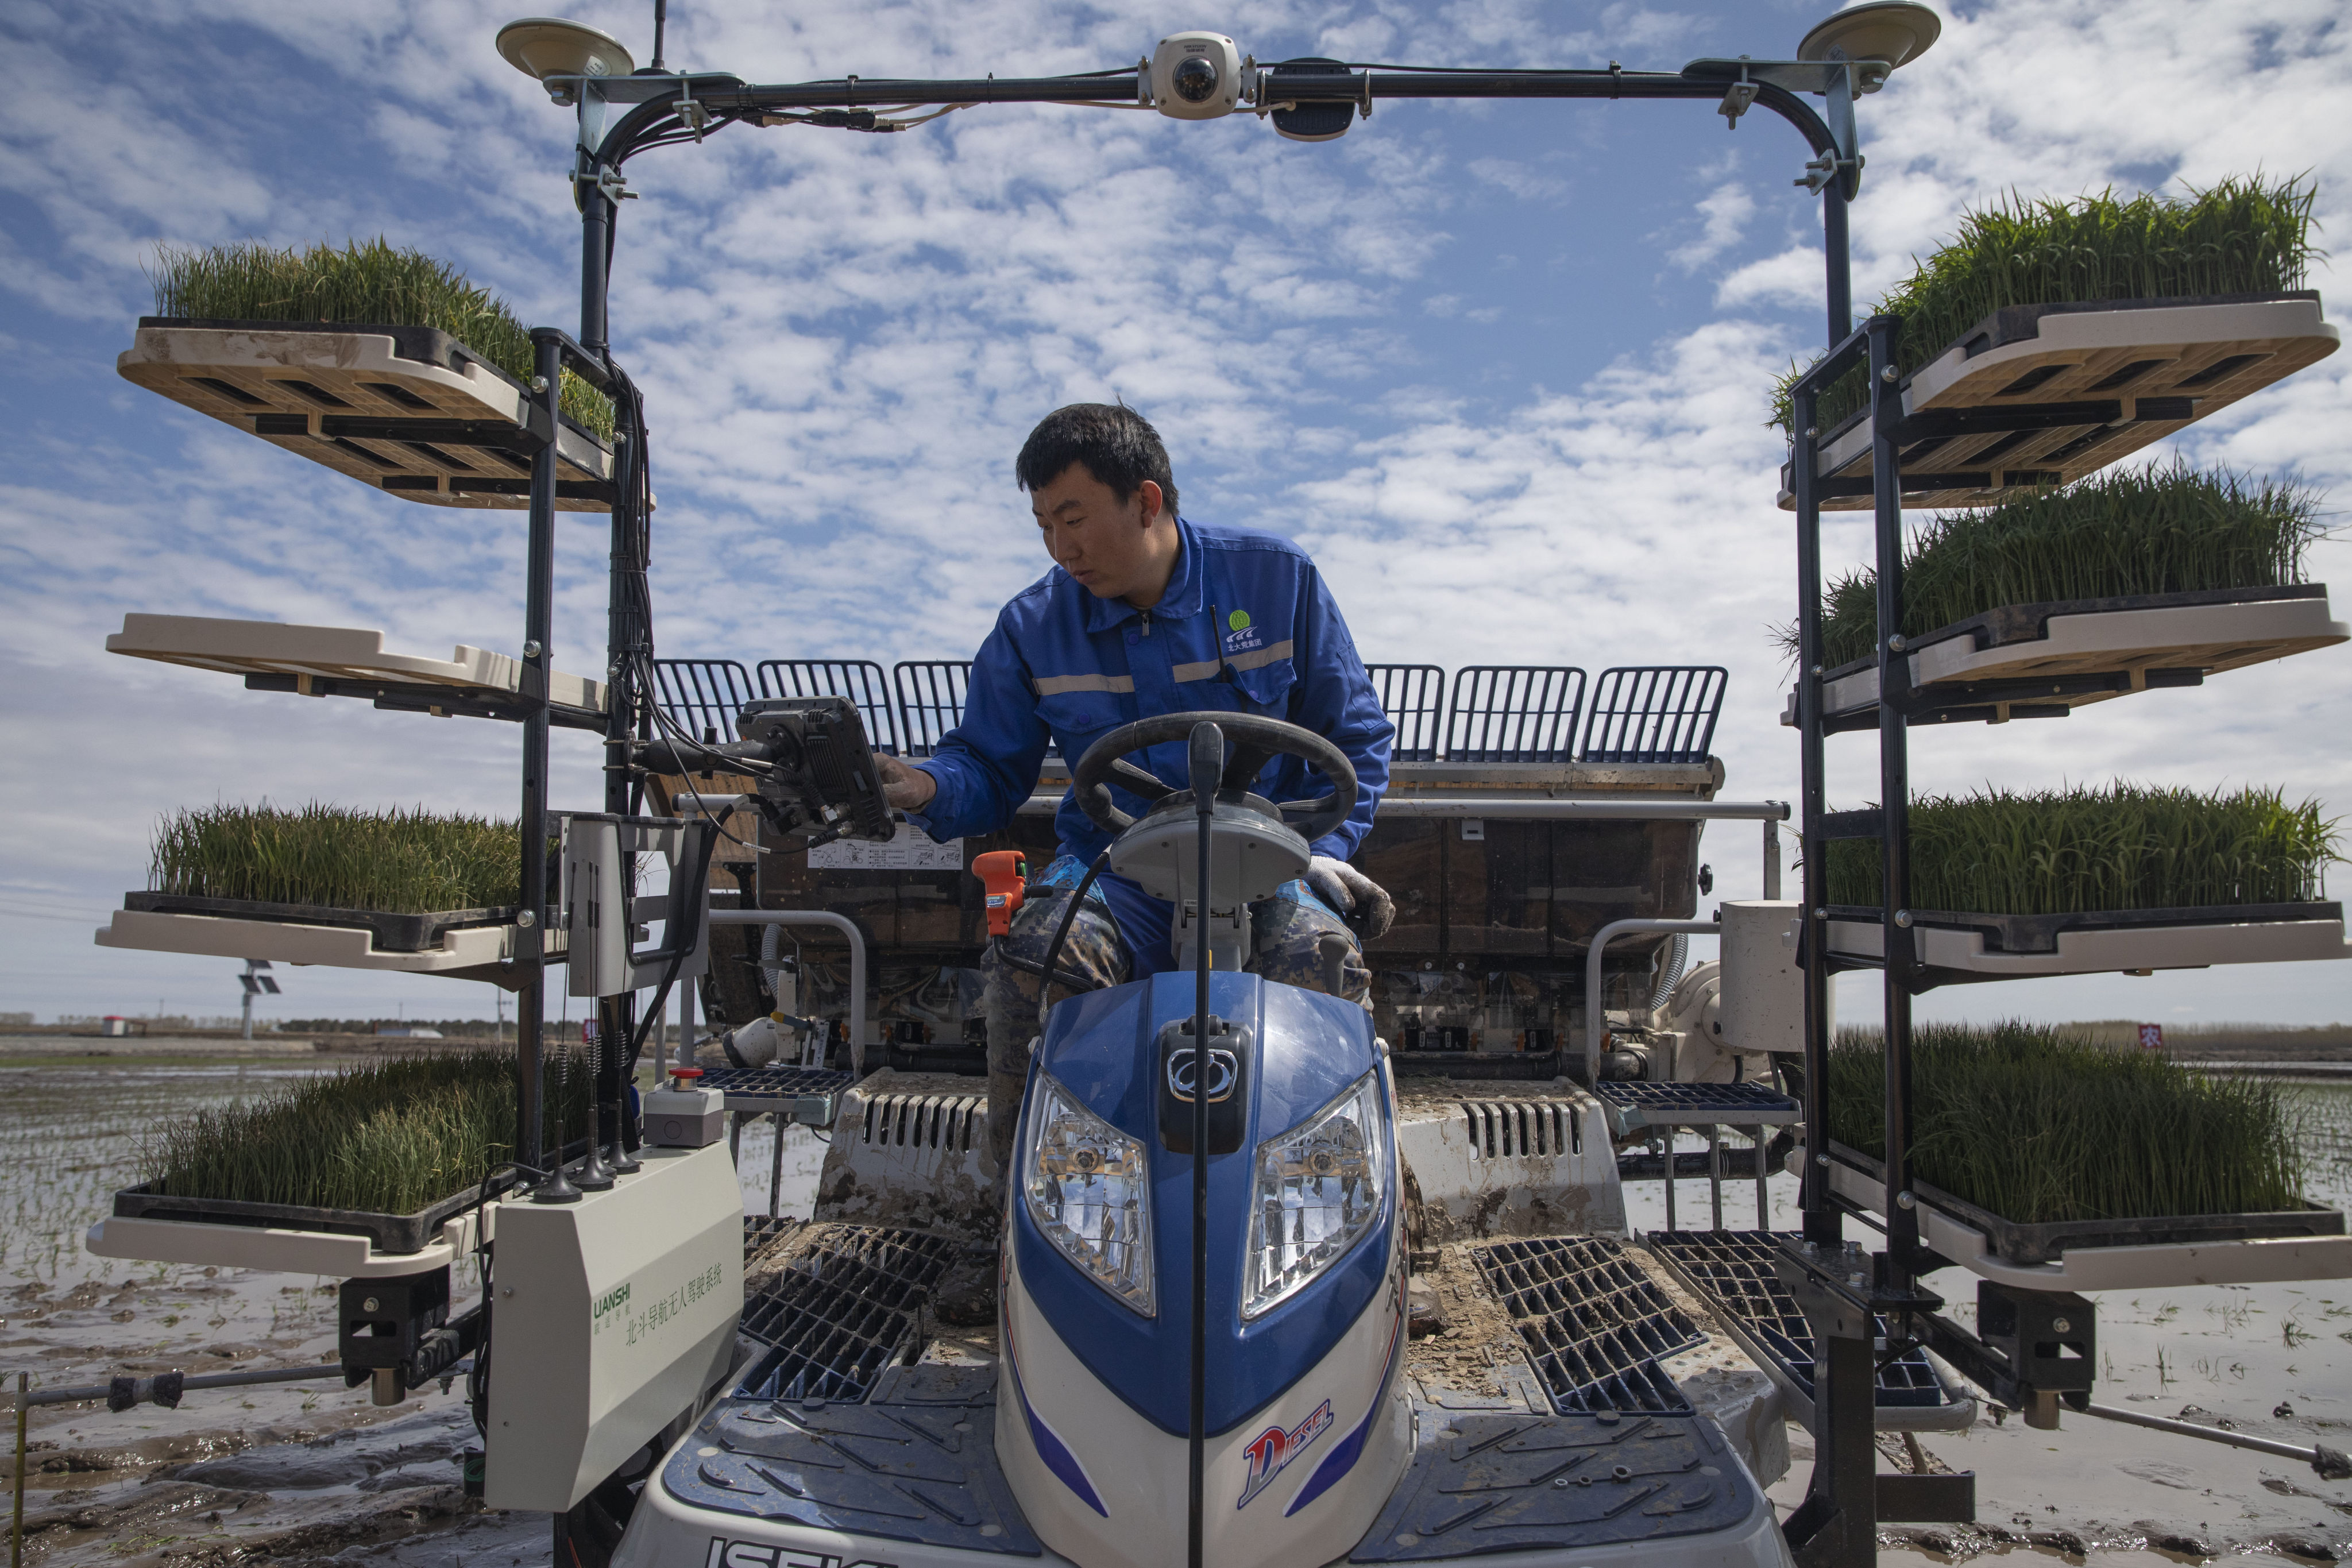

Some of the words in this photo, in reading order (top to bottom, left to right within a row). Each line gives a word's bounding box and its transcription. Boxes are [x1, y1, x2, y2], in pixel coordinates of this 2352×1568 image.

[1228, 639, 1262, 651] 北大荒集团
[626, 1262, 722, 1347] 北斗导航无人驾驶系统
[1238, 1400, 1333, 1508] DIESEL
